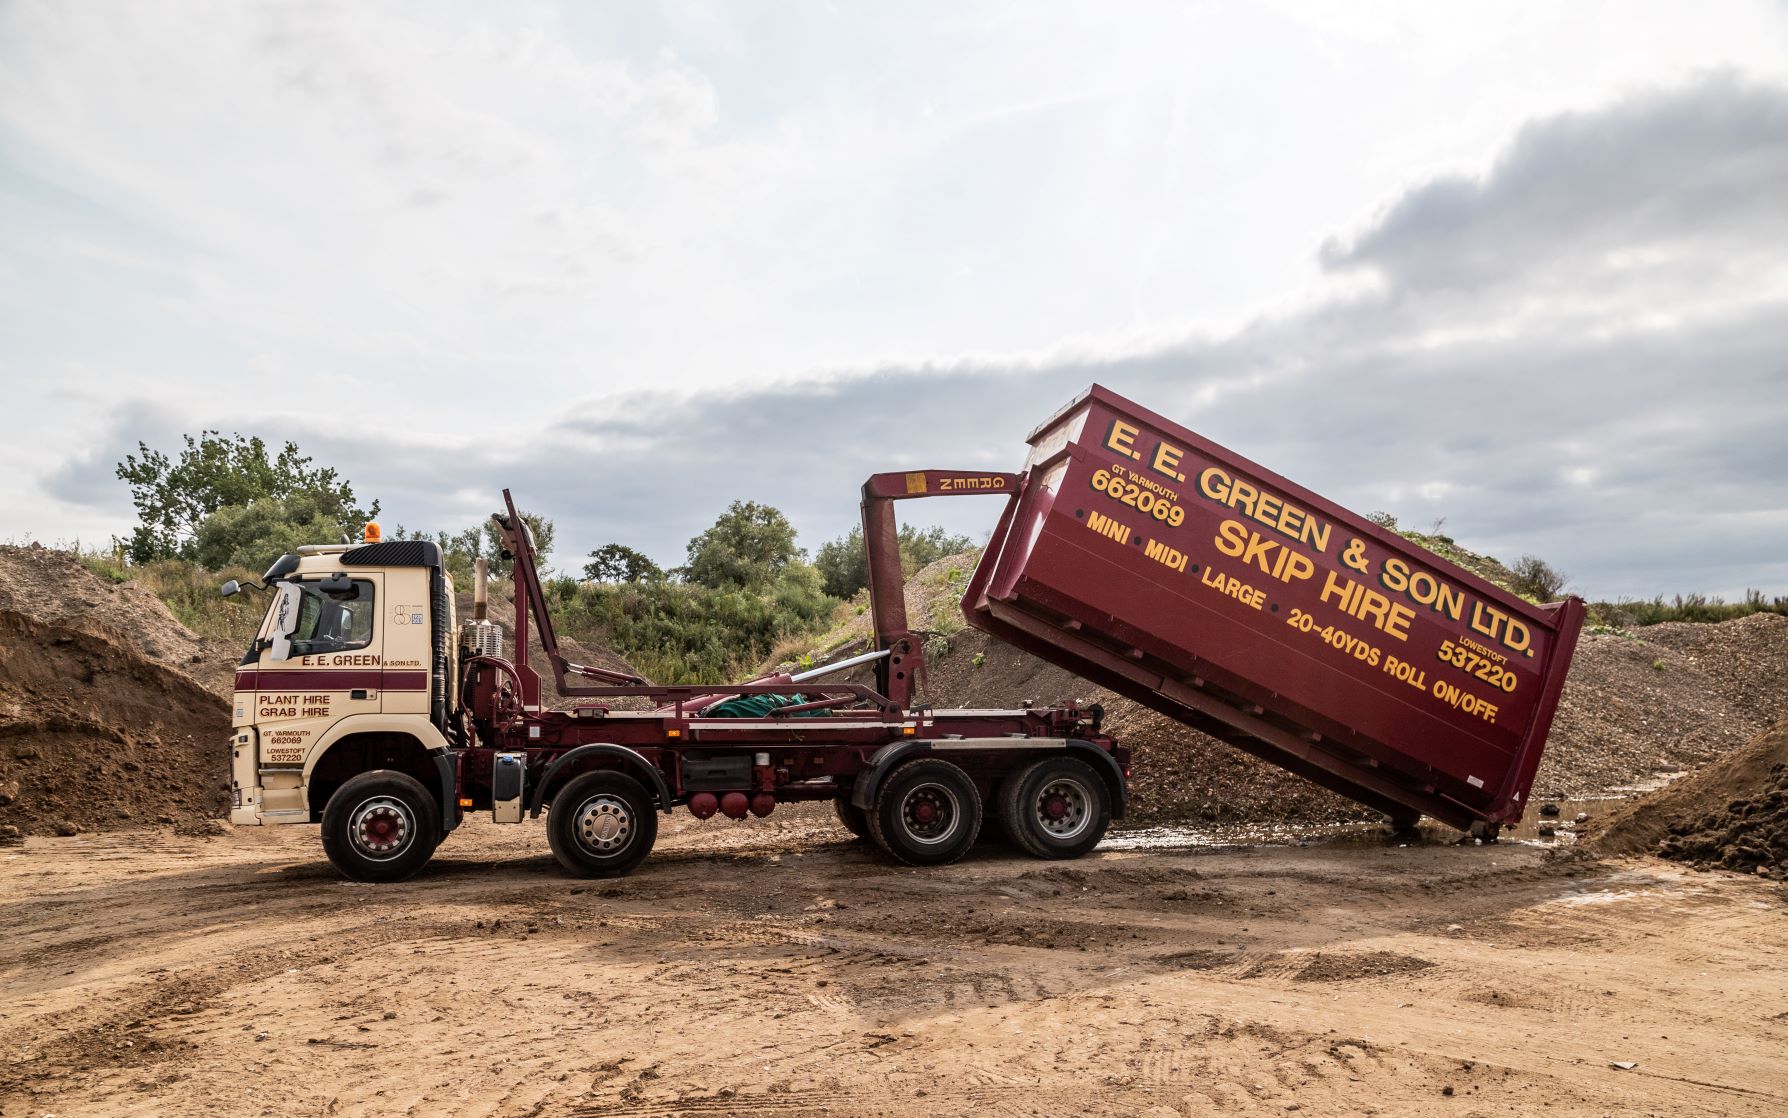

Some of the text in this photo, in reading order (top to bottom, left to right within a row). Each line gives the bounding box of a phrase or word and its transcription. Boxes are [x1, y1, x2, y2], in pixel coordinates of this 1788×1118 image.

[939, 476, 1005, 490] GREEN
[1091, 469, 1185, 527] 662069
[1111, 464, 1178, 502] GT YARMOUTH
[1107, 419, 1535, 658] E. E. GREEN & SON LTD.
[1214, 519, 1417, 642] SKIP HIRE
[1086, 510, 1499, 724] MINI MIDI LARGE 20-40YDS ROLL ON/OFF.
[302, 655, 315, 666] E.
[317, 655, 330, 666] E.
[333, 655, 381, 666] GREEN
[1459, 635, 1508, 665] LOWESTOFT
[1437, 640, 1518, 693] 537220
[260, 695, 330, 705] PLANT HIRE
[260, 707, 330, 717] GRAB HIRE
[271, 736, 302, 744] 662069
[271, 754, 302, 762] 537220
